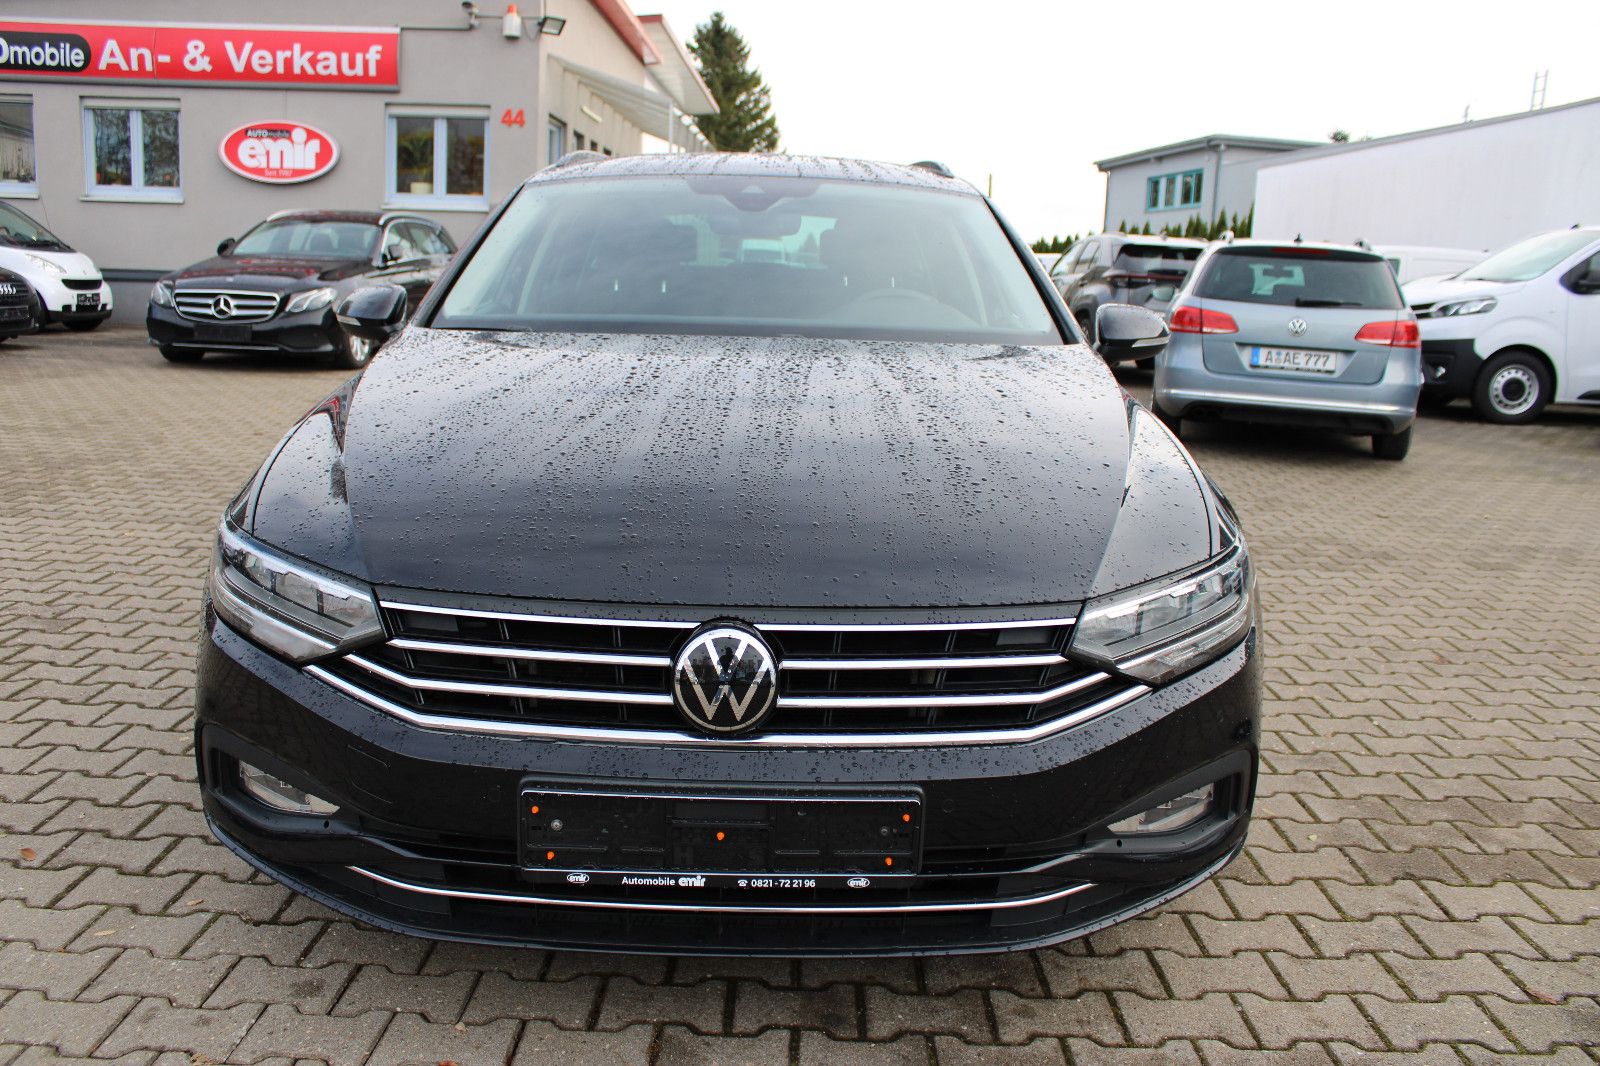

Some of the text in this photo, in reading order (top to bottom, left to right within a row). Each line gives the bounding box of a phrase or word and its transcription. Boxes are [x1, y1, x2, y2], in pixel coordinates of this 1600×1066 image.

[98, 39, 171, 71] An-
[183, 39, 213, 72] &
[224, 41, 383, 77] Verkauf
[501, 108, 525, 128] 44
[238, 128, 320, 170] emir
[621, 875, 706, 887] Automobile emir
